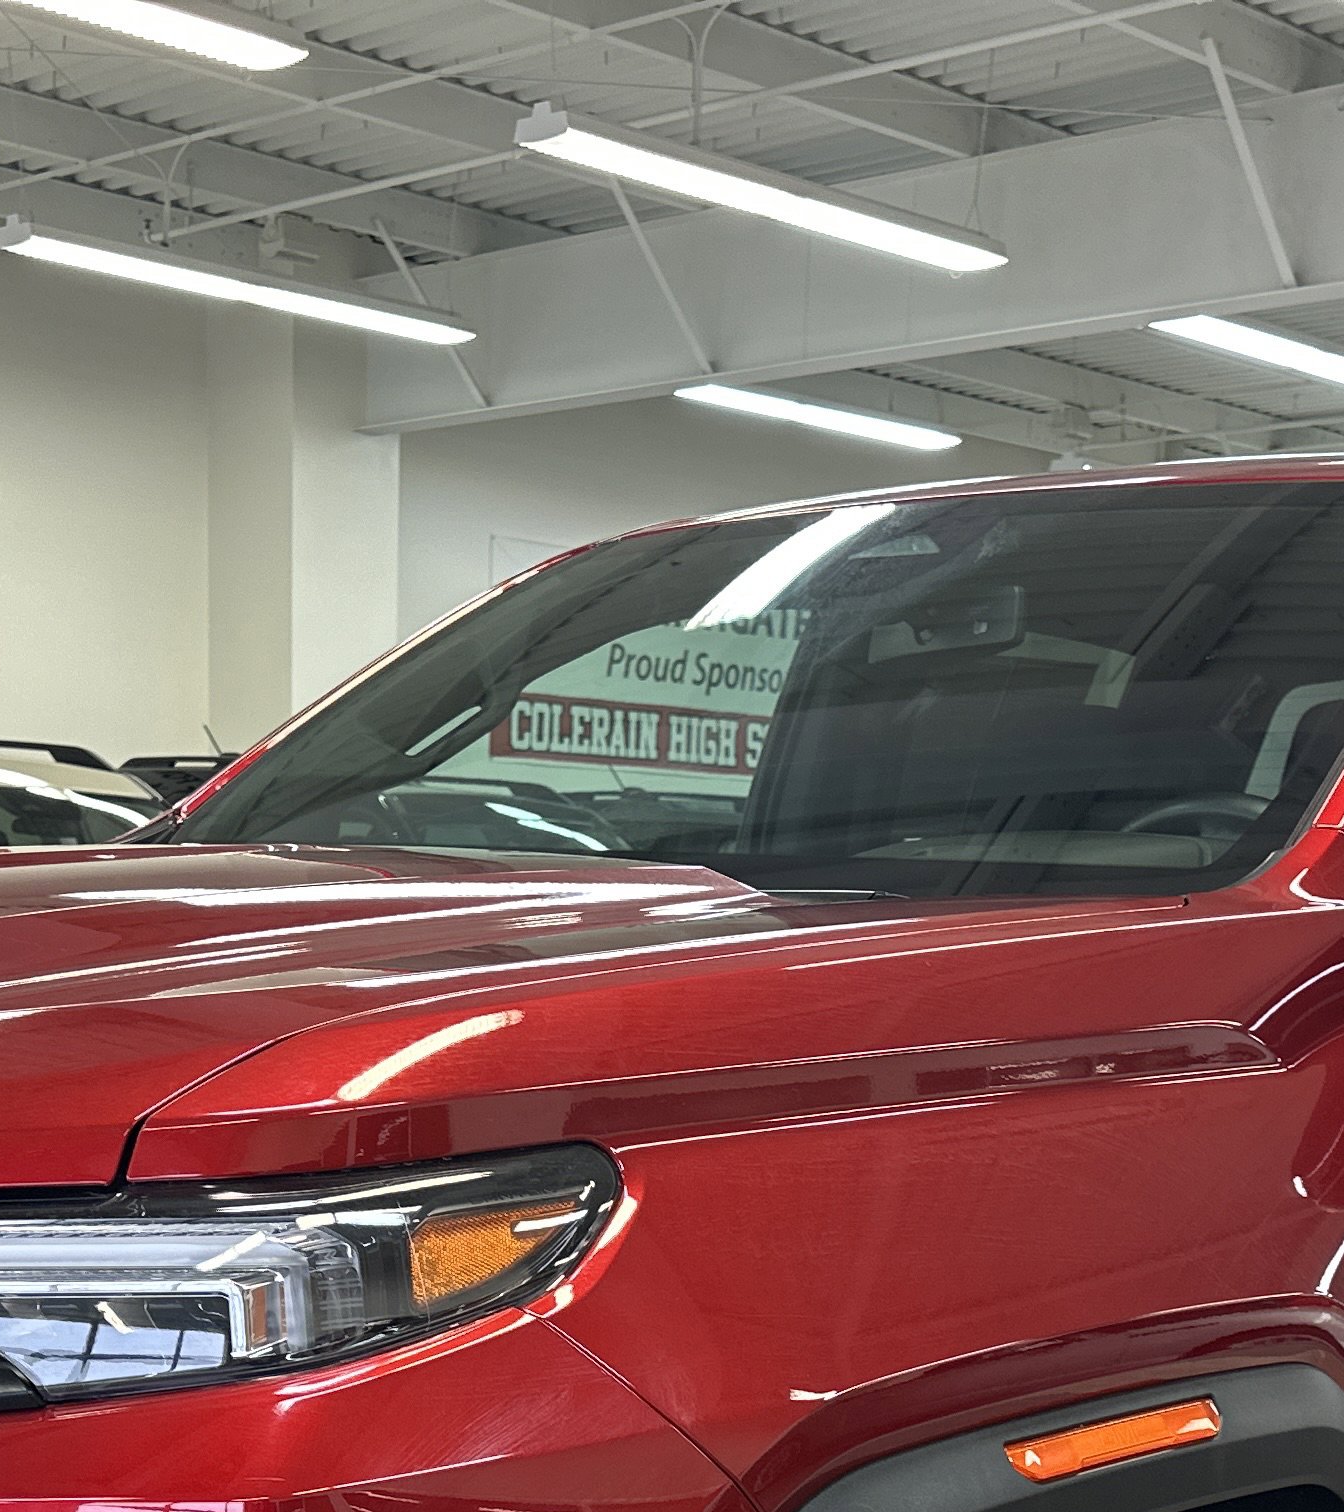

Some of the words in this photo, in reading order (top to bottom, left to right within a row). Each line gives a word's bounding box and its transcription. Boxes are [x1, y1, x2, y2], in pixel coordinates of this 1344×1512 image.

[606, 643, 689, 685] Proud
[691, 652, 783, 696] Sponso
[510, 701, 661, 761] COLERAIN
[667, 714, 739, 768] HIGH
